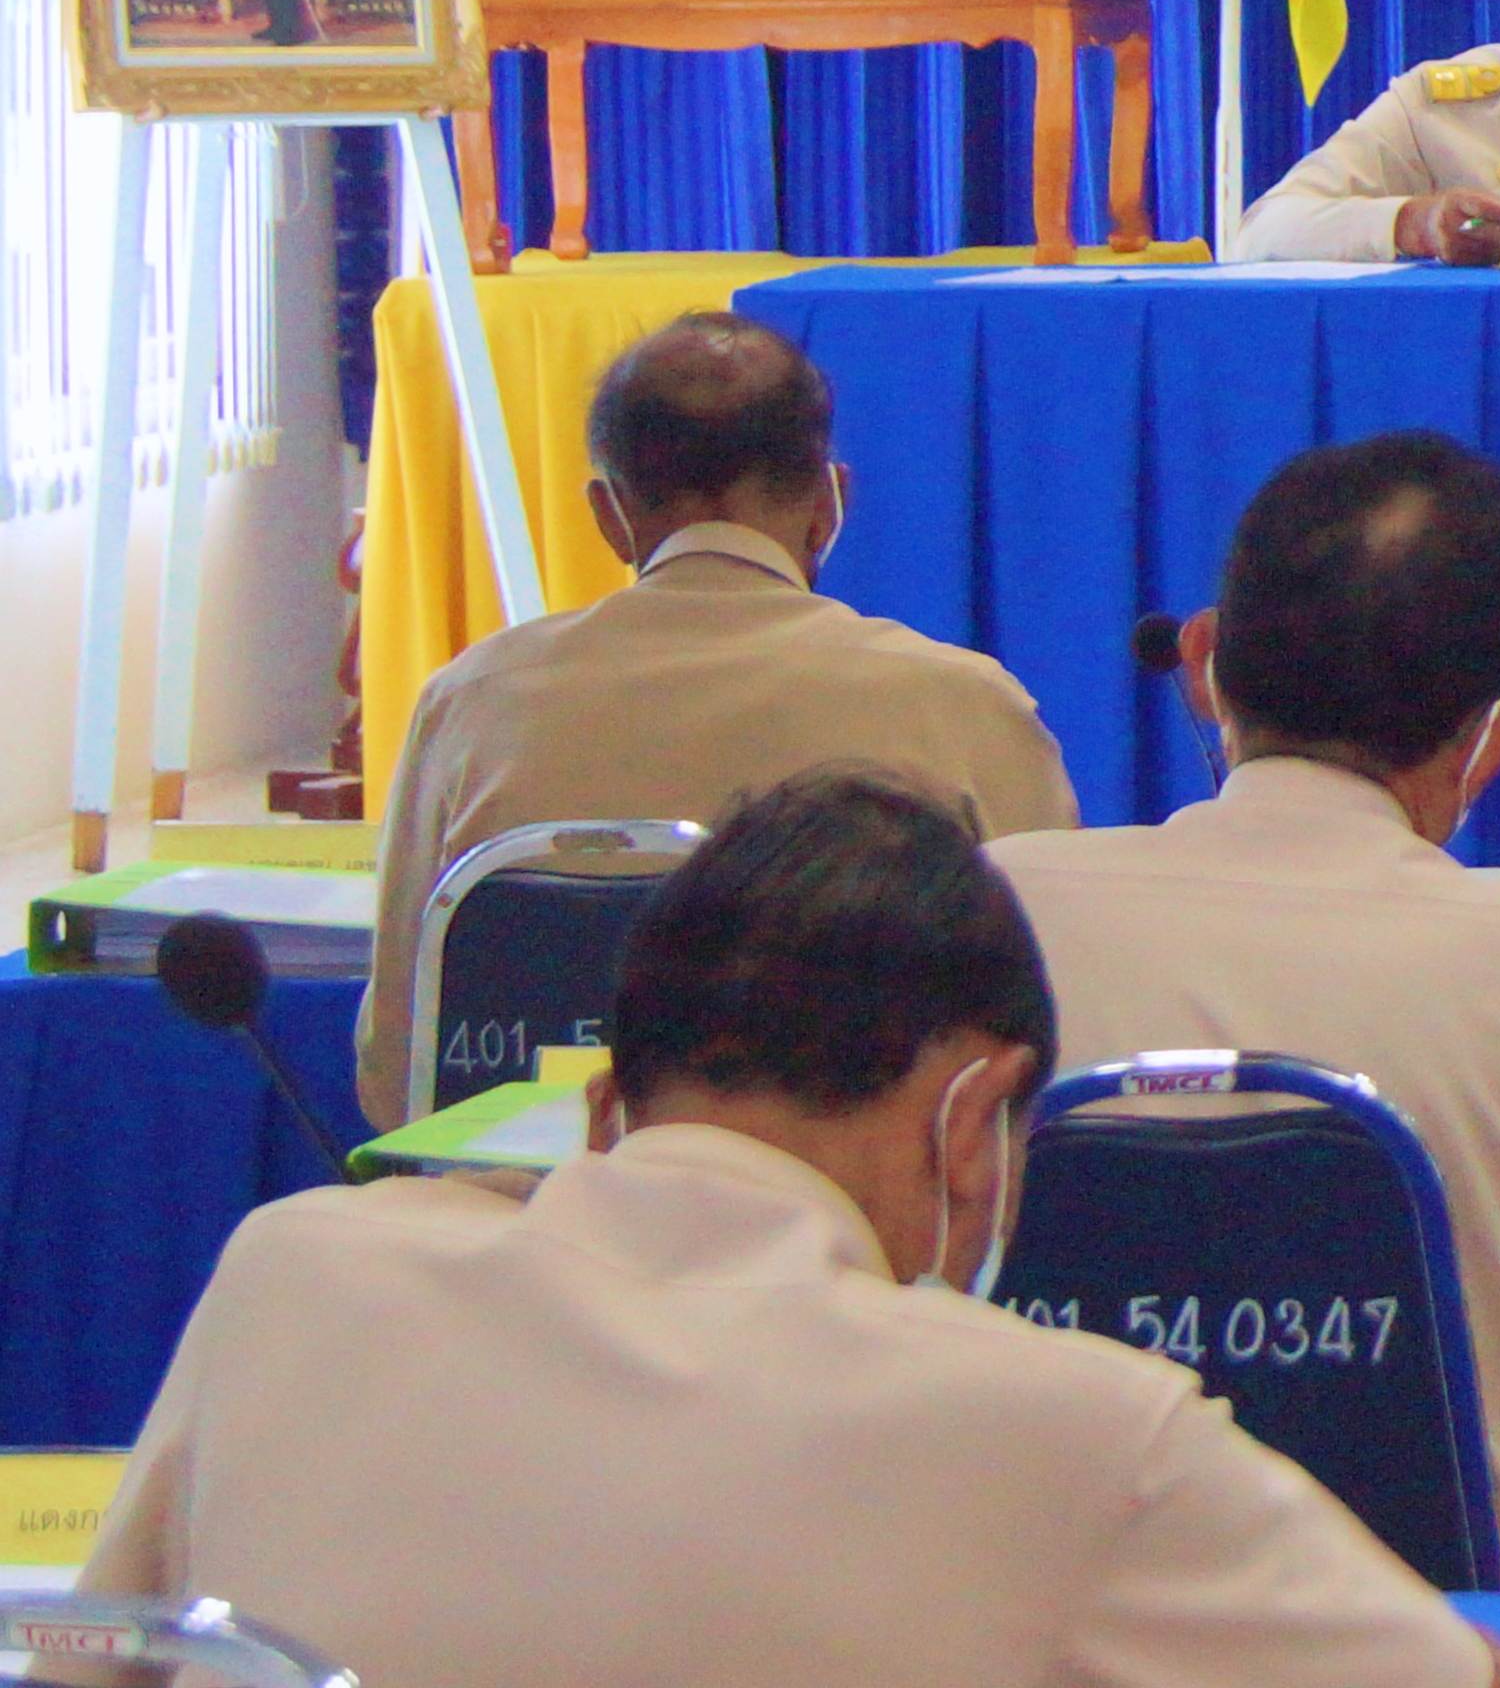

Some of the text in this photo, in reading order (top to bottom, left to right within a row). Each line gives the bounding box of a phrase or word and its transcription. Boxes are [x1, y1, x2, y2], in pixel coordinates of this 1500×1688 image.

[443, 1019, 527, 1074] 401
[1125, 1294, 1206, 1364] 54
[1225, 1294, 1400, 1366] 0347
